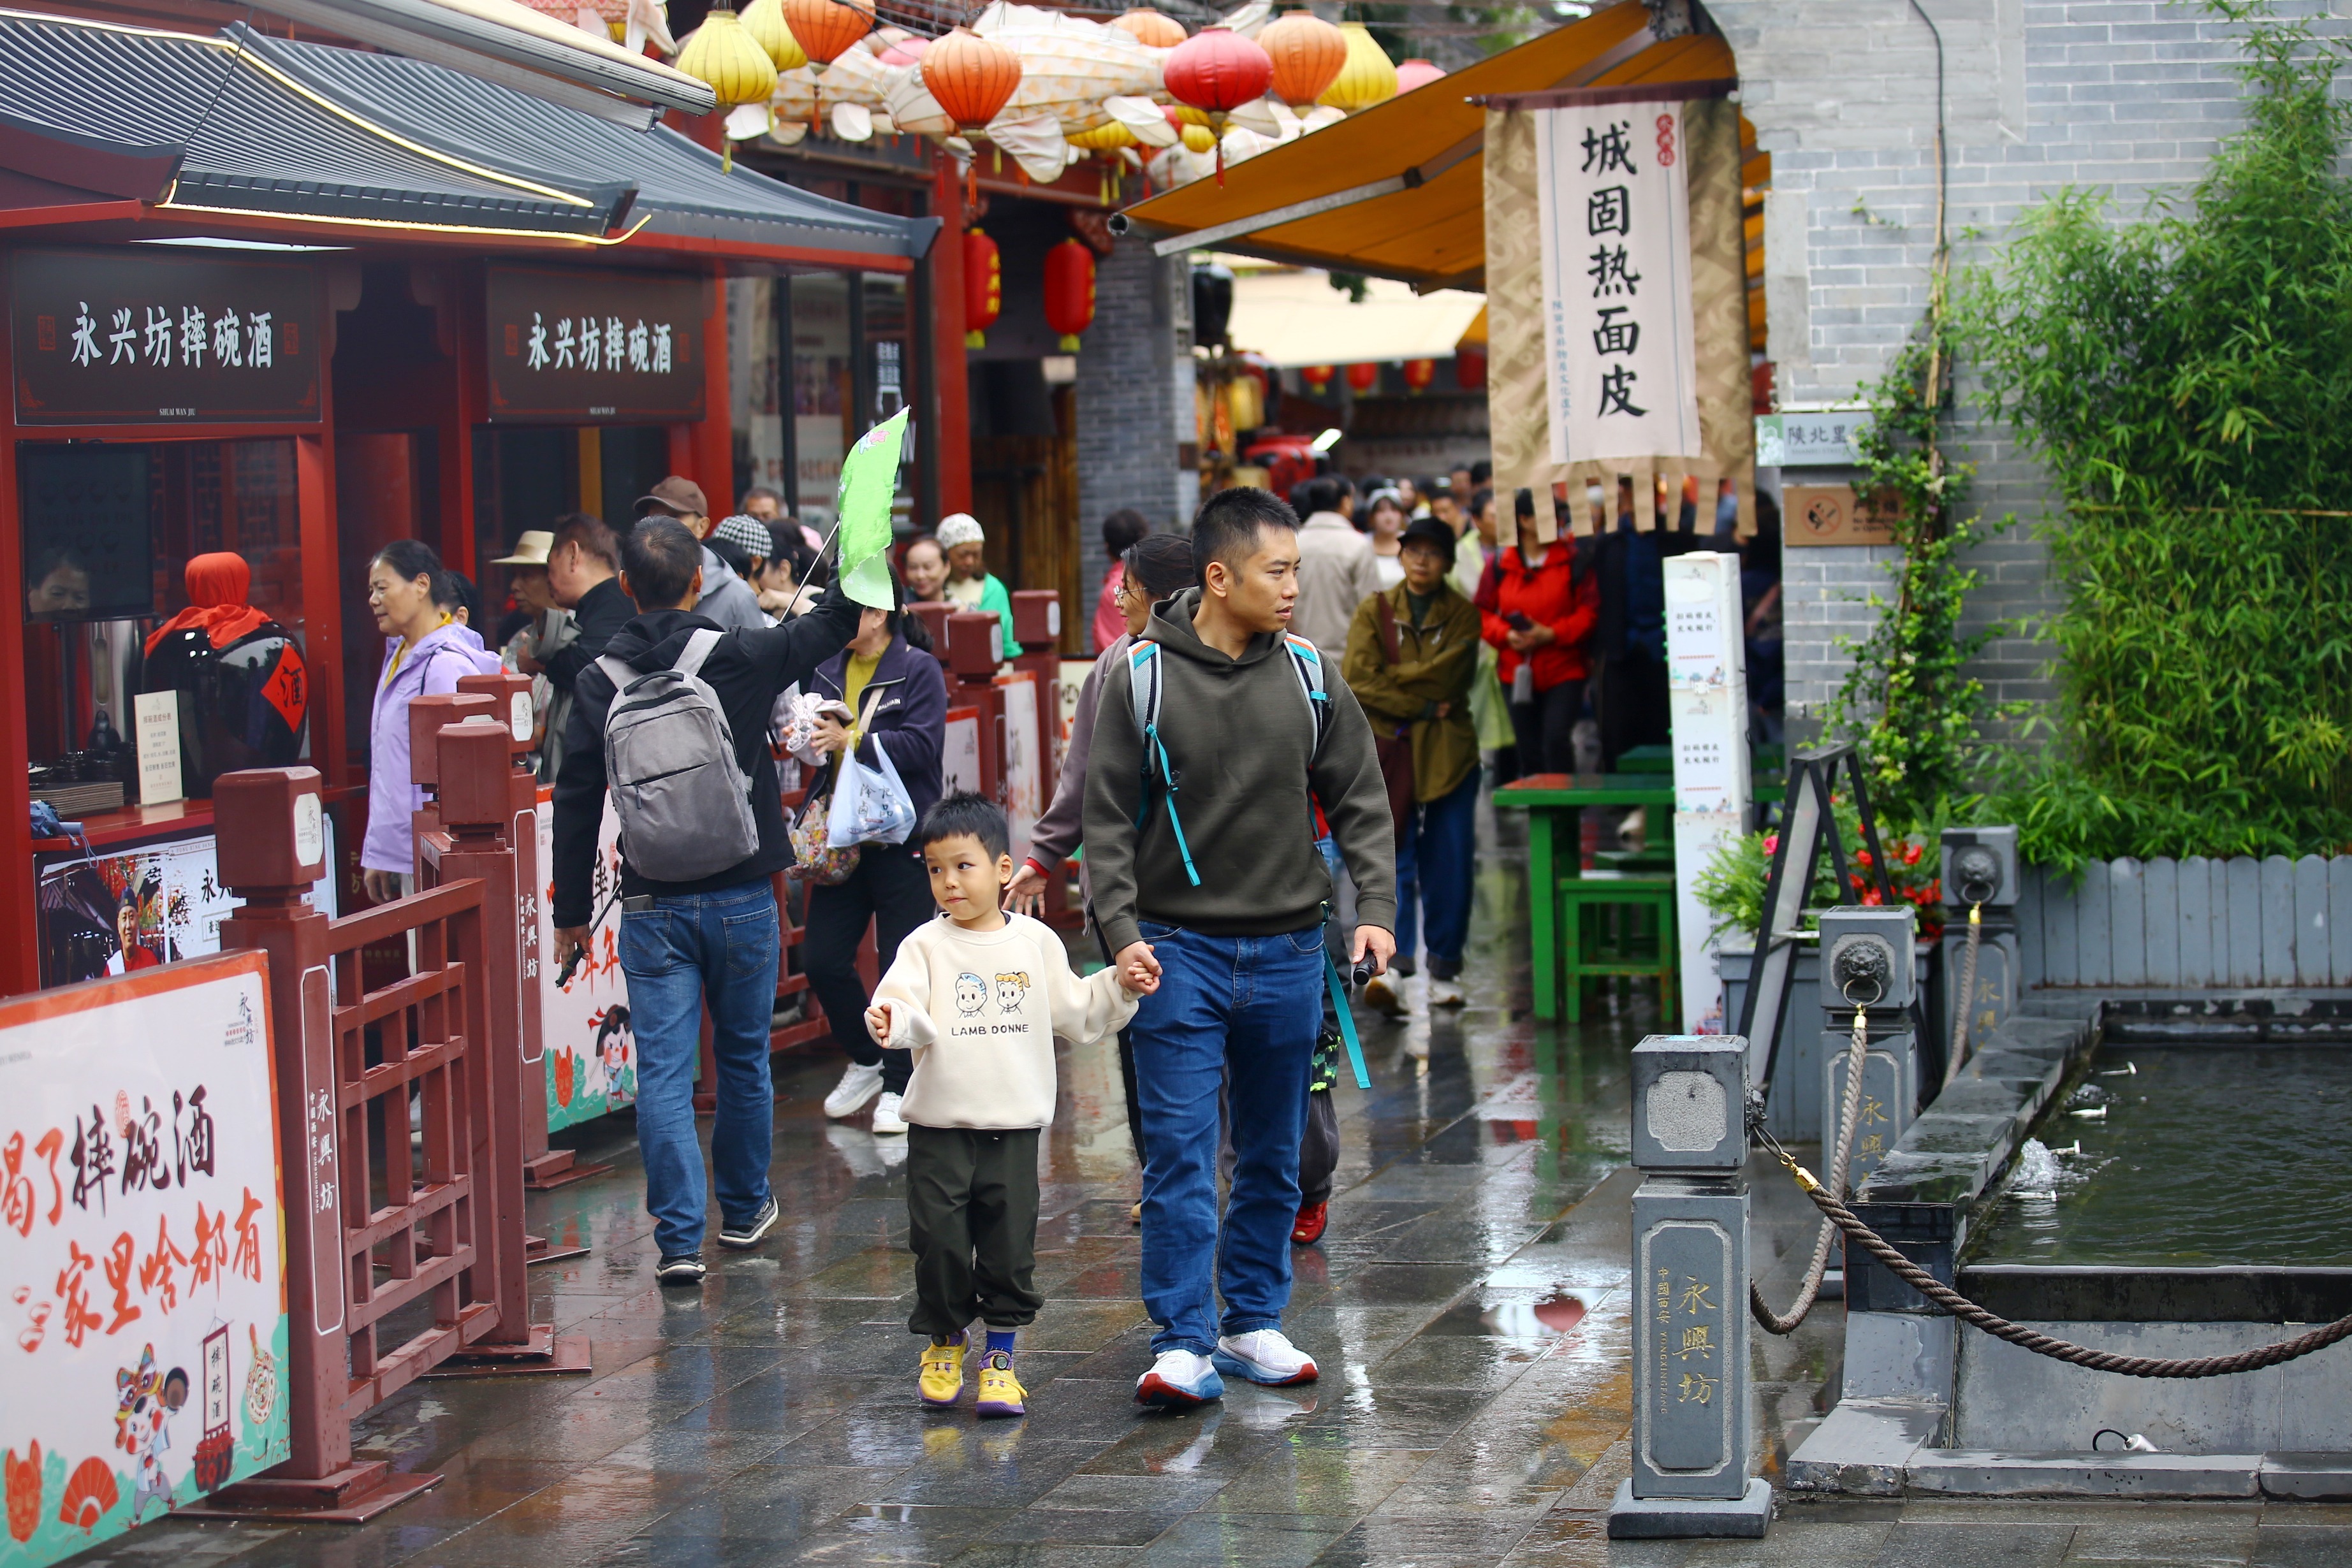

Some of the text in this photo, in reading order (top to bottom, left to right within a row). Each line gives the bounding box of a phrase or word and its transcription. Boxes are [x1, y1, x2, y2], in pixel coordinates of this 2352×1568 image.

[1581, 120, 1650, 419] 城固热面皮
[71, 301, 273, 368] 永兴坊摔碗酒
[527, 312, 672, 374] 永兴坊摔碗酒
[1788, 425, 1847, 445] 陕北里
[281, 665, 304, 707] 酒
[877, 698, 901, 711] BALMAIN
[525, 893, 539, 980] 永興坊
[951, 1024, 1029, 1036] LAMB DONNE
[318, 1089, 335, 1210] 永興坊
[56, 1186, 264, 1349] 家里啥都有
[1656, 1267, 1671, 1324] 中國西安
[1660, 1332, 1668, 1414] YONGXINGFANG
[1672, 1275, 1719, 1404] 永興坊
[211, 1345, 223, 1420] 摔碗酒
